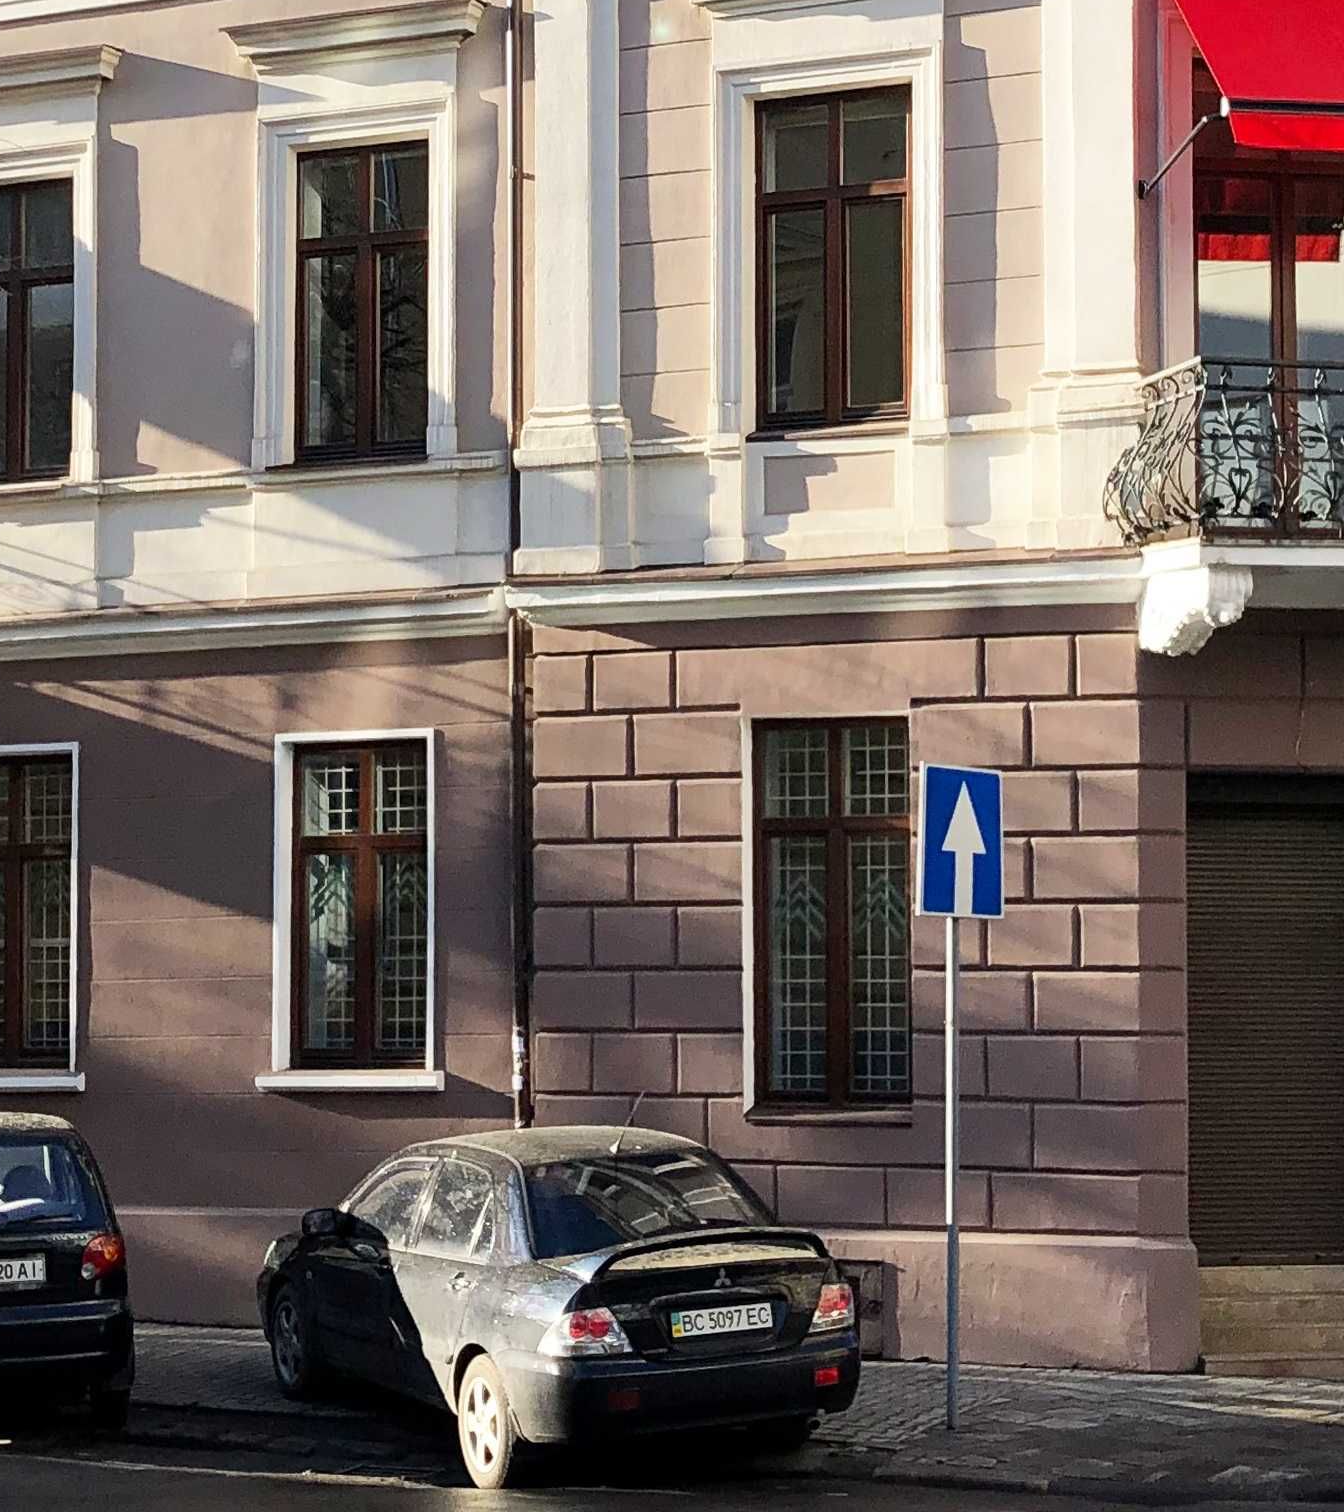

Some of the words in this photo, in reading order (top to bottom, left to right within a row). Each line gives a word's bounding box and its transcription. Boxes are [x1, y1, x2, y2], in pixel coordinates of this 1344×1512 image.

[17, 1262, 37, 1279] AI
[681, 1313, 705, 1333] BC
[707, 1309, 743, 1330] 5097
[746, 1306, 769, 1326] EC
